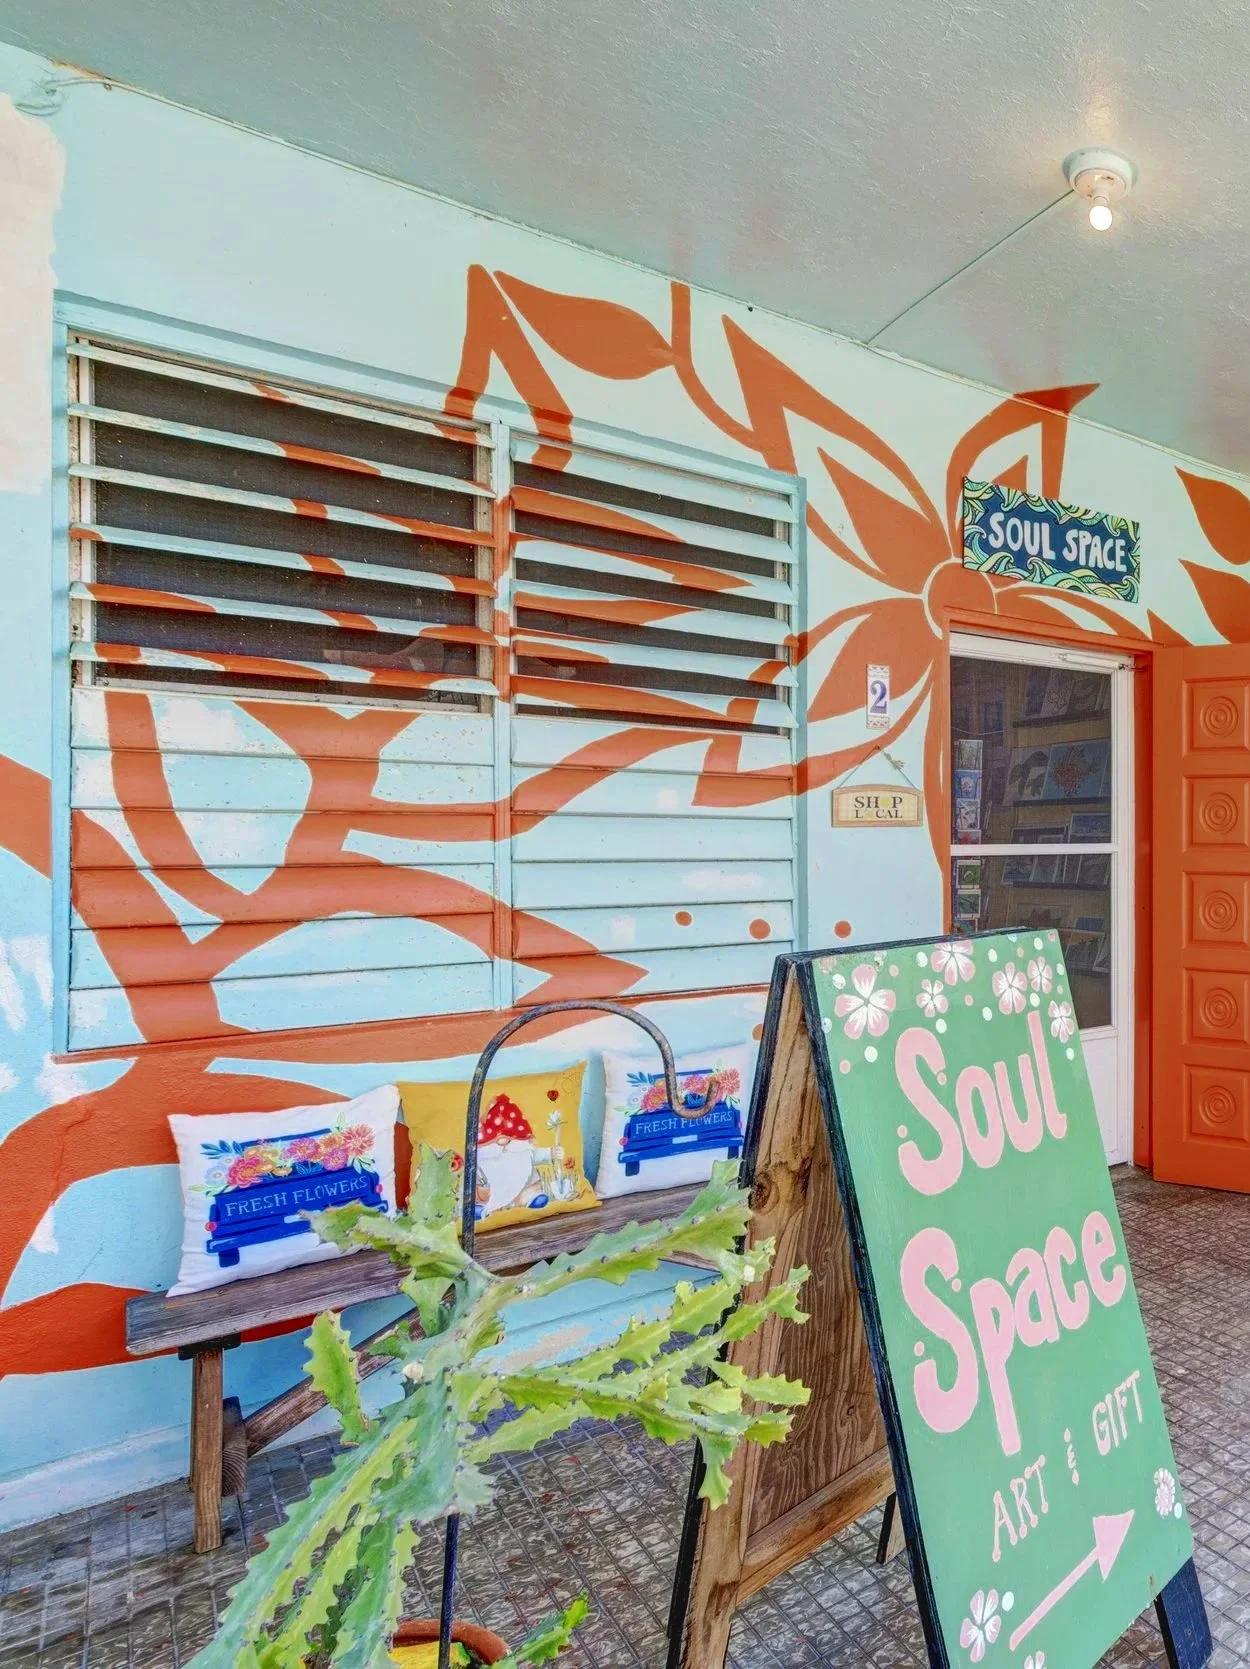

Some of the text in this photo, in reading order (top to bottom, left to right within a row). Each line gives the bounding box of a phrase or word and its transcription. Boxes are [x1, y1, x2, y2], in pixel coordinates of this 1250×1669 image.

[988, 512, 1127, 572] SOUL SPACE
[869, 679, 888, 715] 2
[635, 1110, 735, 1135] FRESH FLOWERS
[894, 1010, 1068, 1196] Soul
[225, 1175, 368, 1217] FRESH FLOWERS
[899, 1211, 1126, 1457] Space
[992, 1454, 1048, 1562] ART
[1092, 1369, 1143, 1456] GIFT
